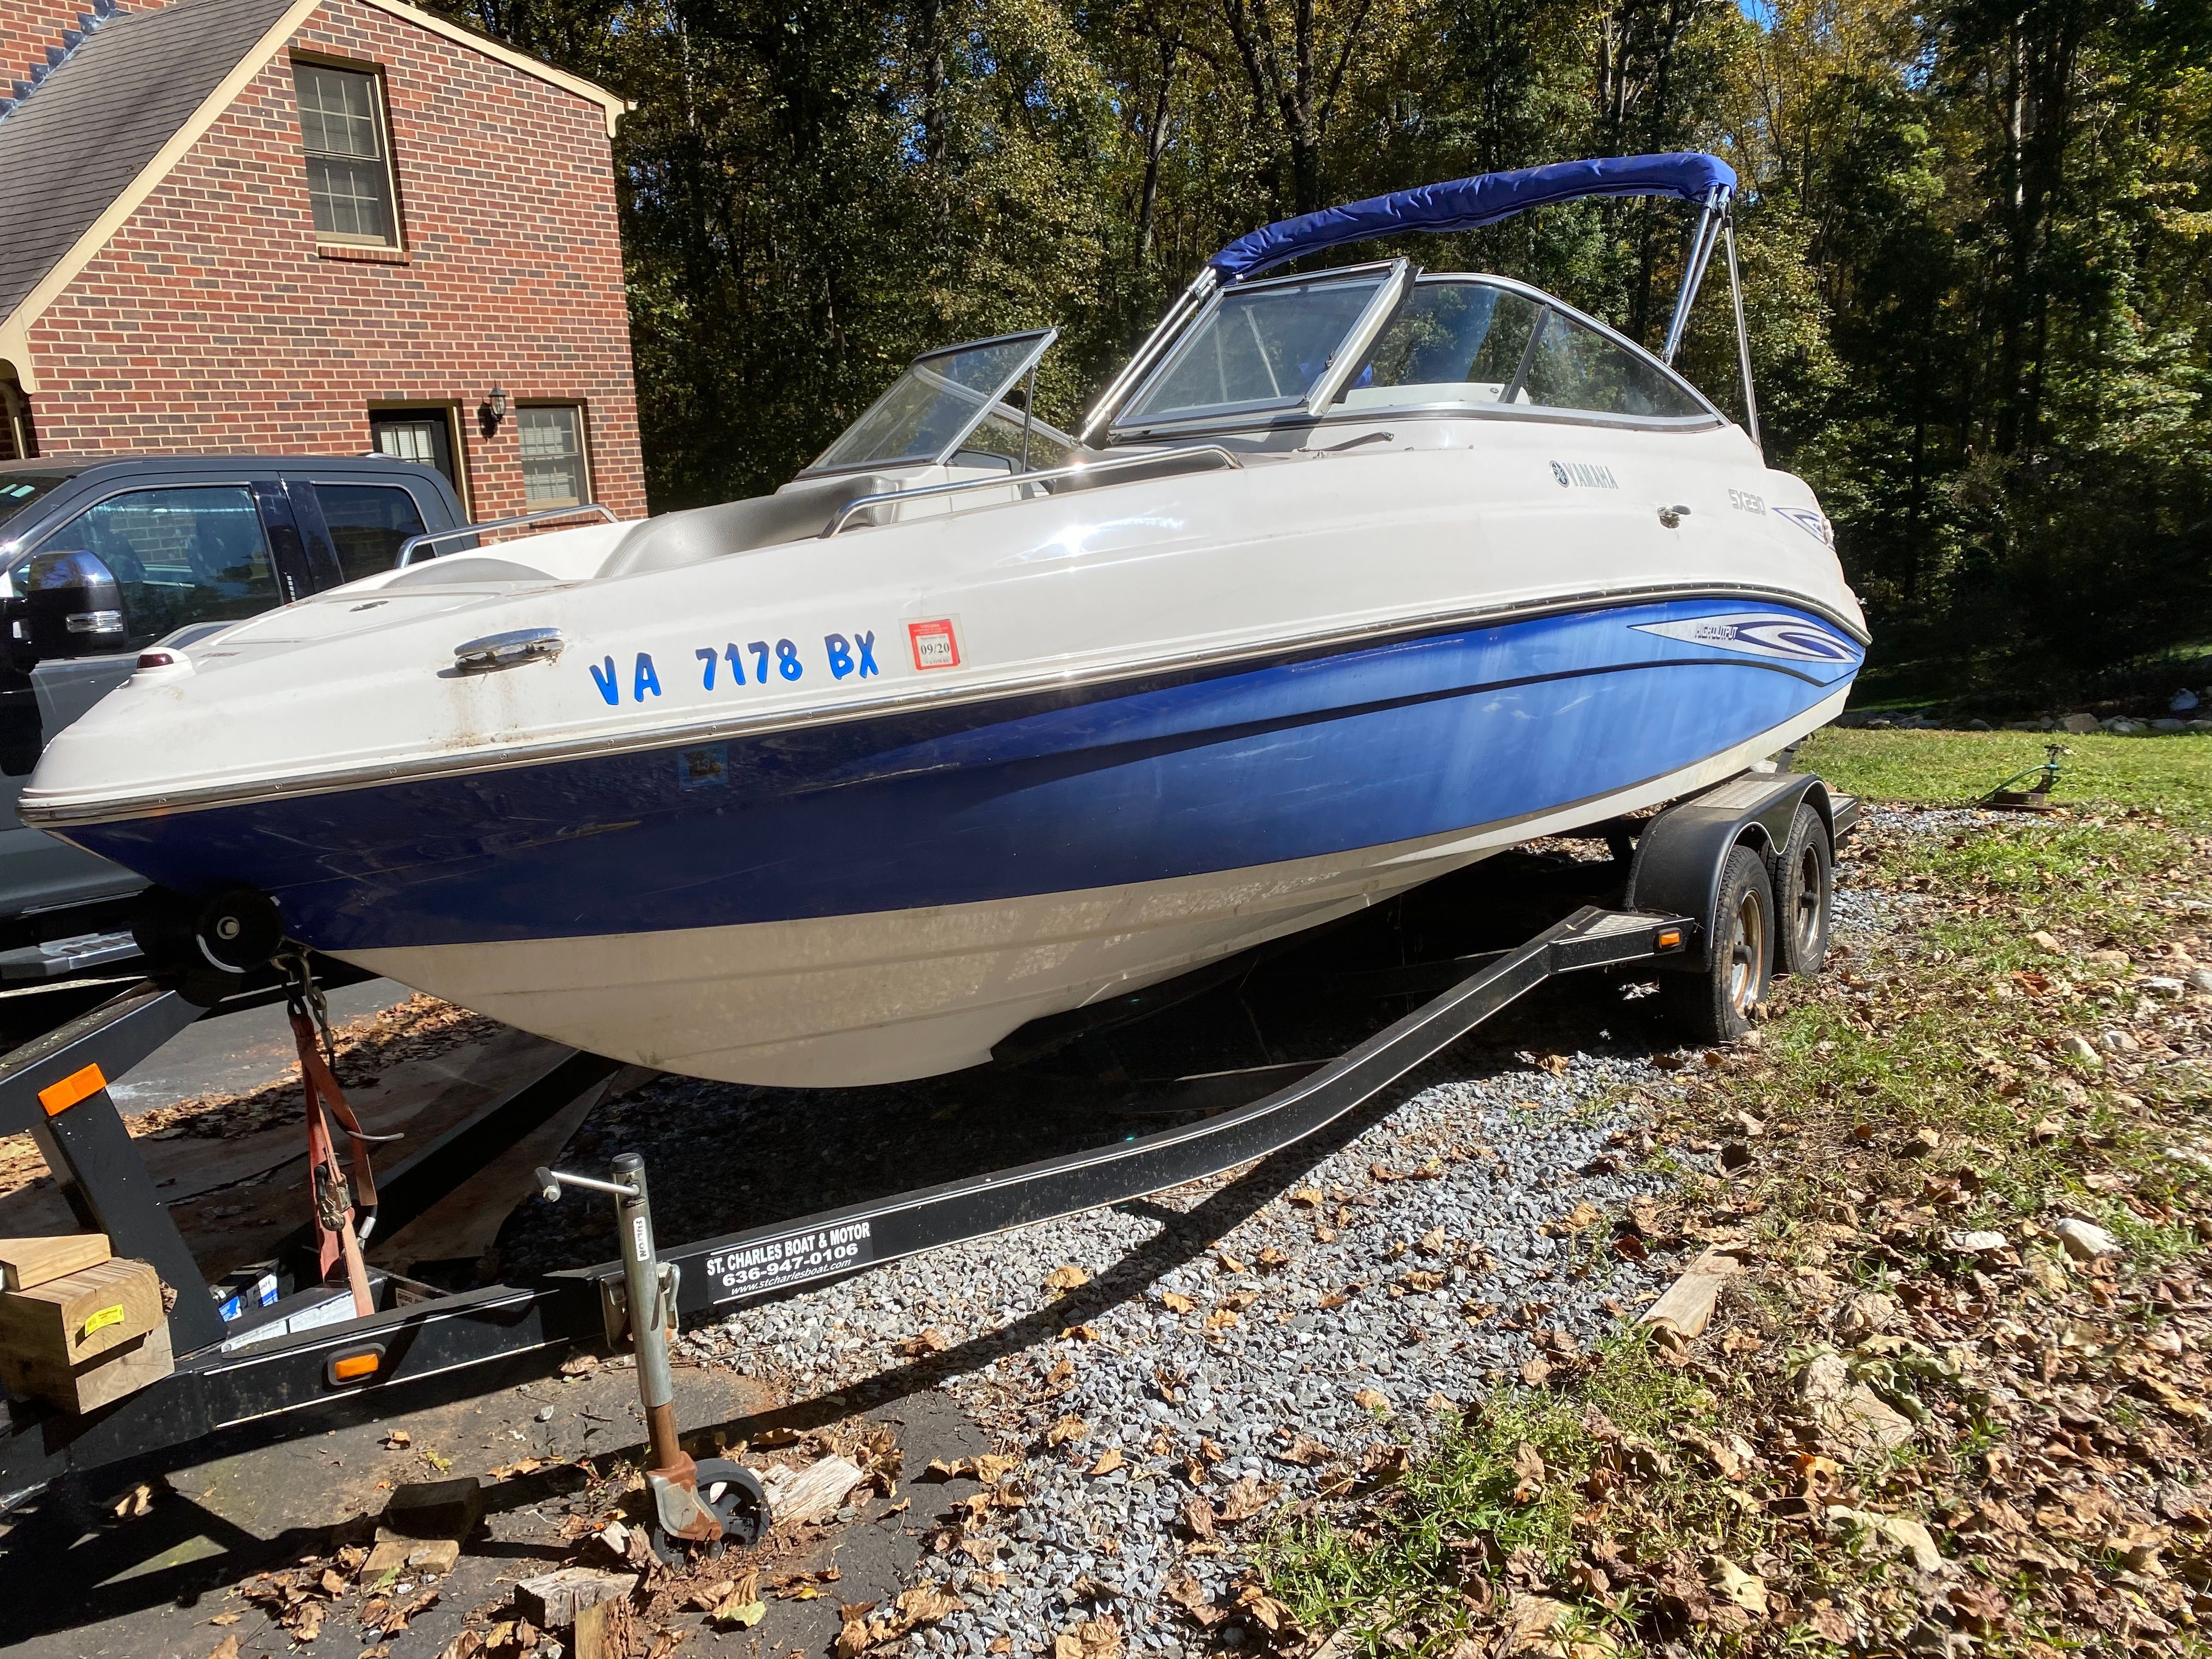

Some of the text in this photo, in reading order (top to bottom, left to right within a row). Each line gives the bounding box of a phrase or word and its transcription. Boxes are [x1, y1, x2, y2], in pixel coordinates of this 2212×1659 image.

[1561, 462, 1619, 489] YAMAHA
[1728, 488, 1767, 516] SX230
[921, 642, 950, 654] 09/20
[589, 652, 662, 706] VA
[695, 638, 803, 691] 7178
[825, 630, 879, 680] BX
[707, 1221, 871, 1276] ST. CHARLES BOAT & MOTOR
[722, 1243, 858, 1286] 636-947-0106
[731, 1259, 851, 1296] www.stcharlesboat.com
[398, 1293, 413, 1303] DISC
